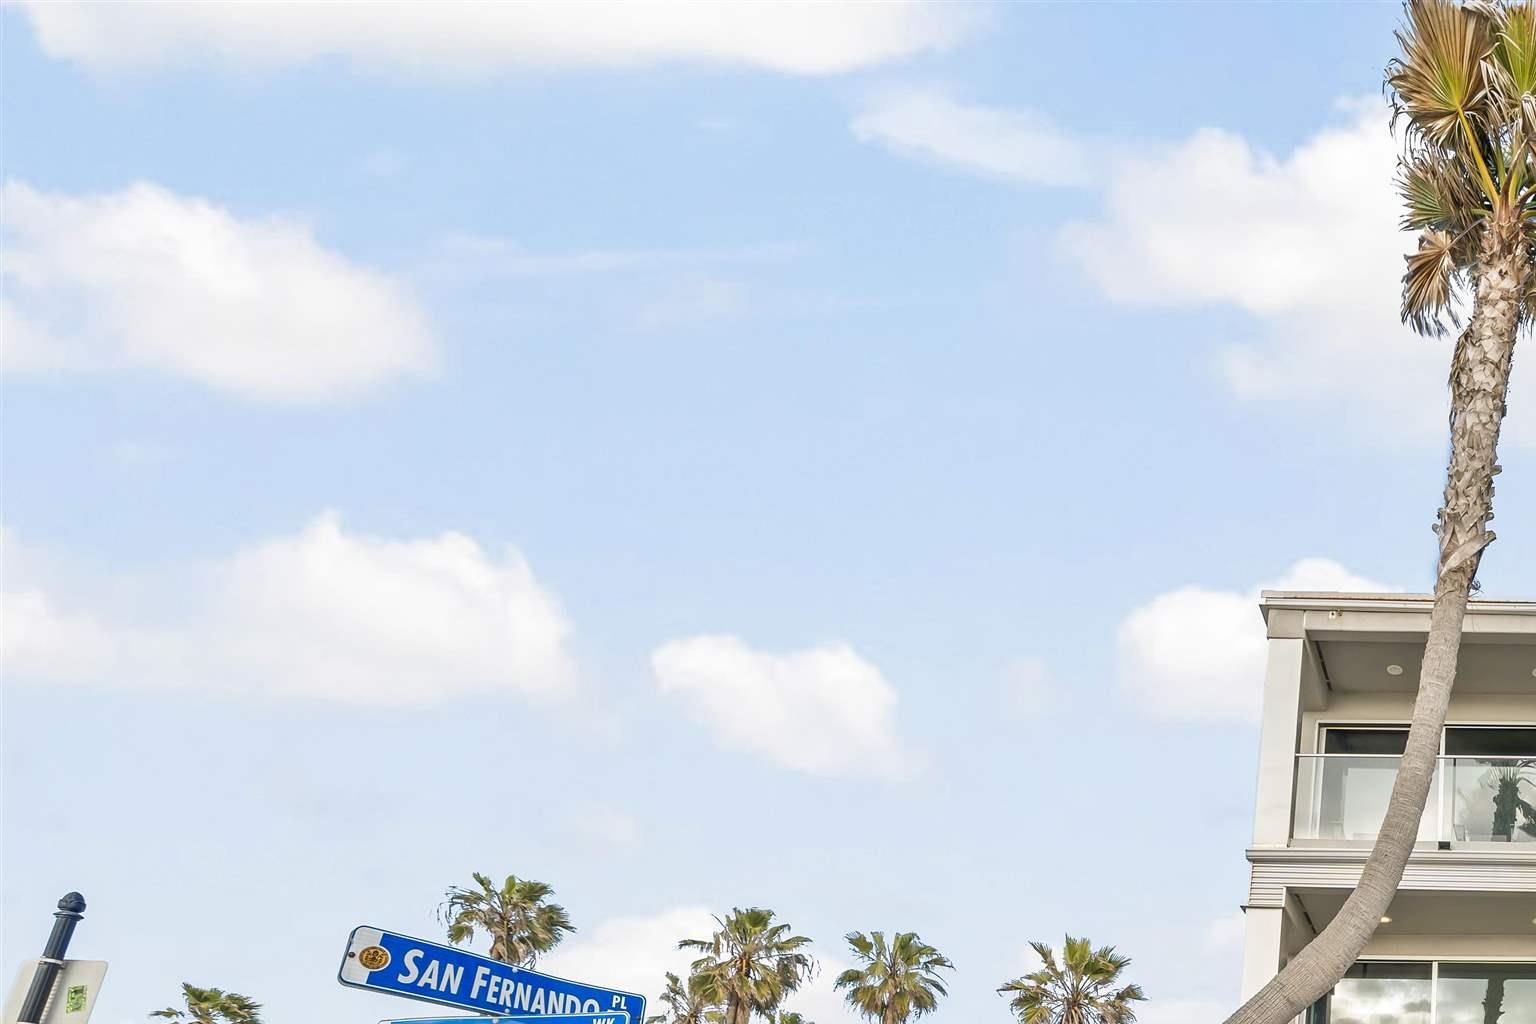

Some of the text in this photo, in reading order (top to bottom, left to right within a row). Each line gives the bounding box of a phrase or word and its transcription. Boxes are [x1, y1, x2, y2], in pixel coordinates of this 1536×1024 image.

[397, 948, 600, 1014] SAN FERNANDO
[612, 995, 627, 1009] PL
